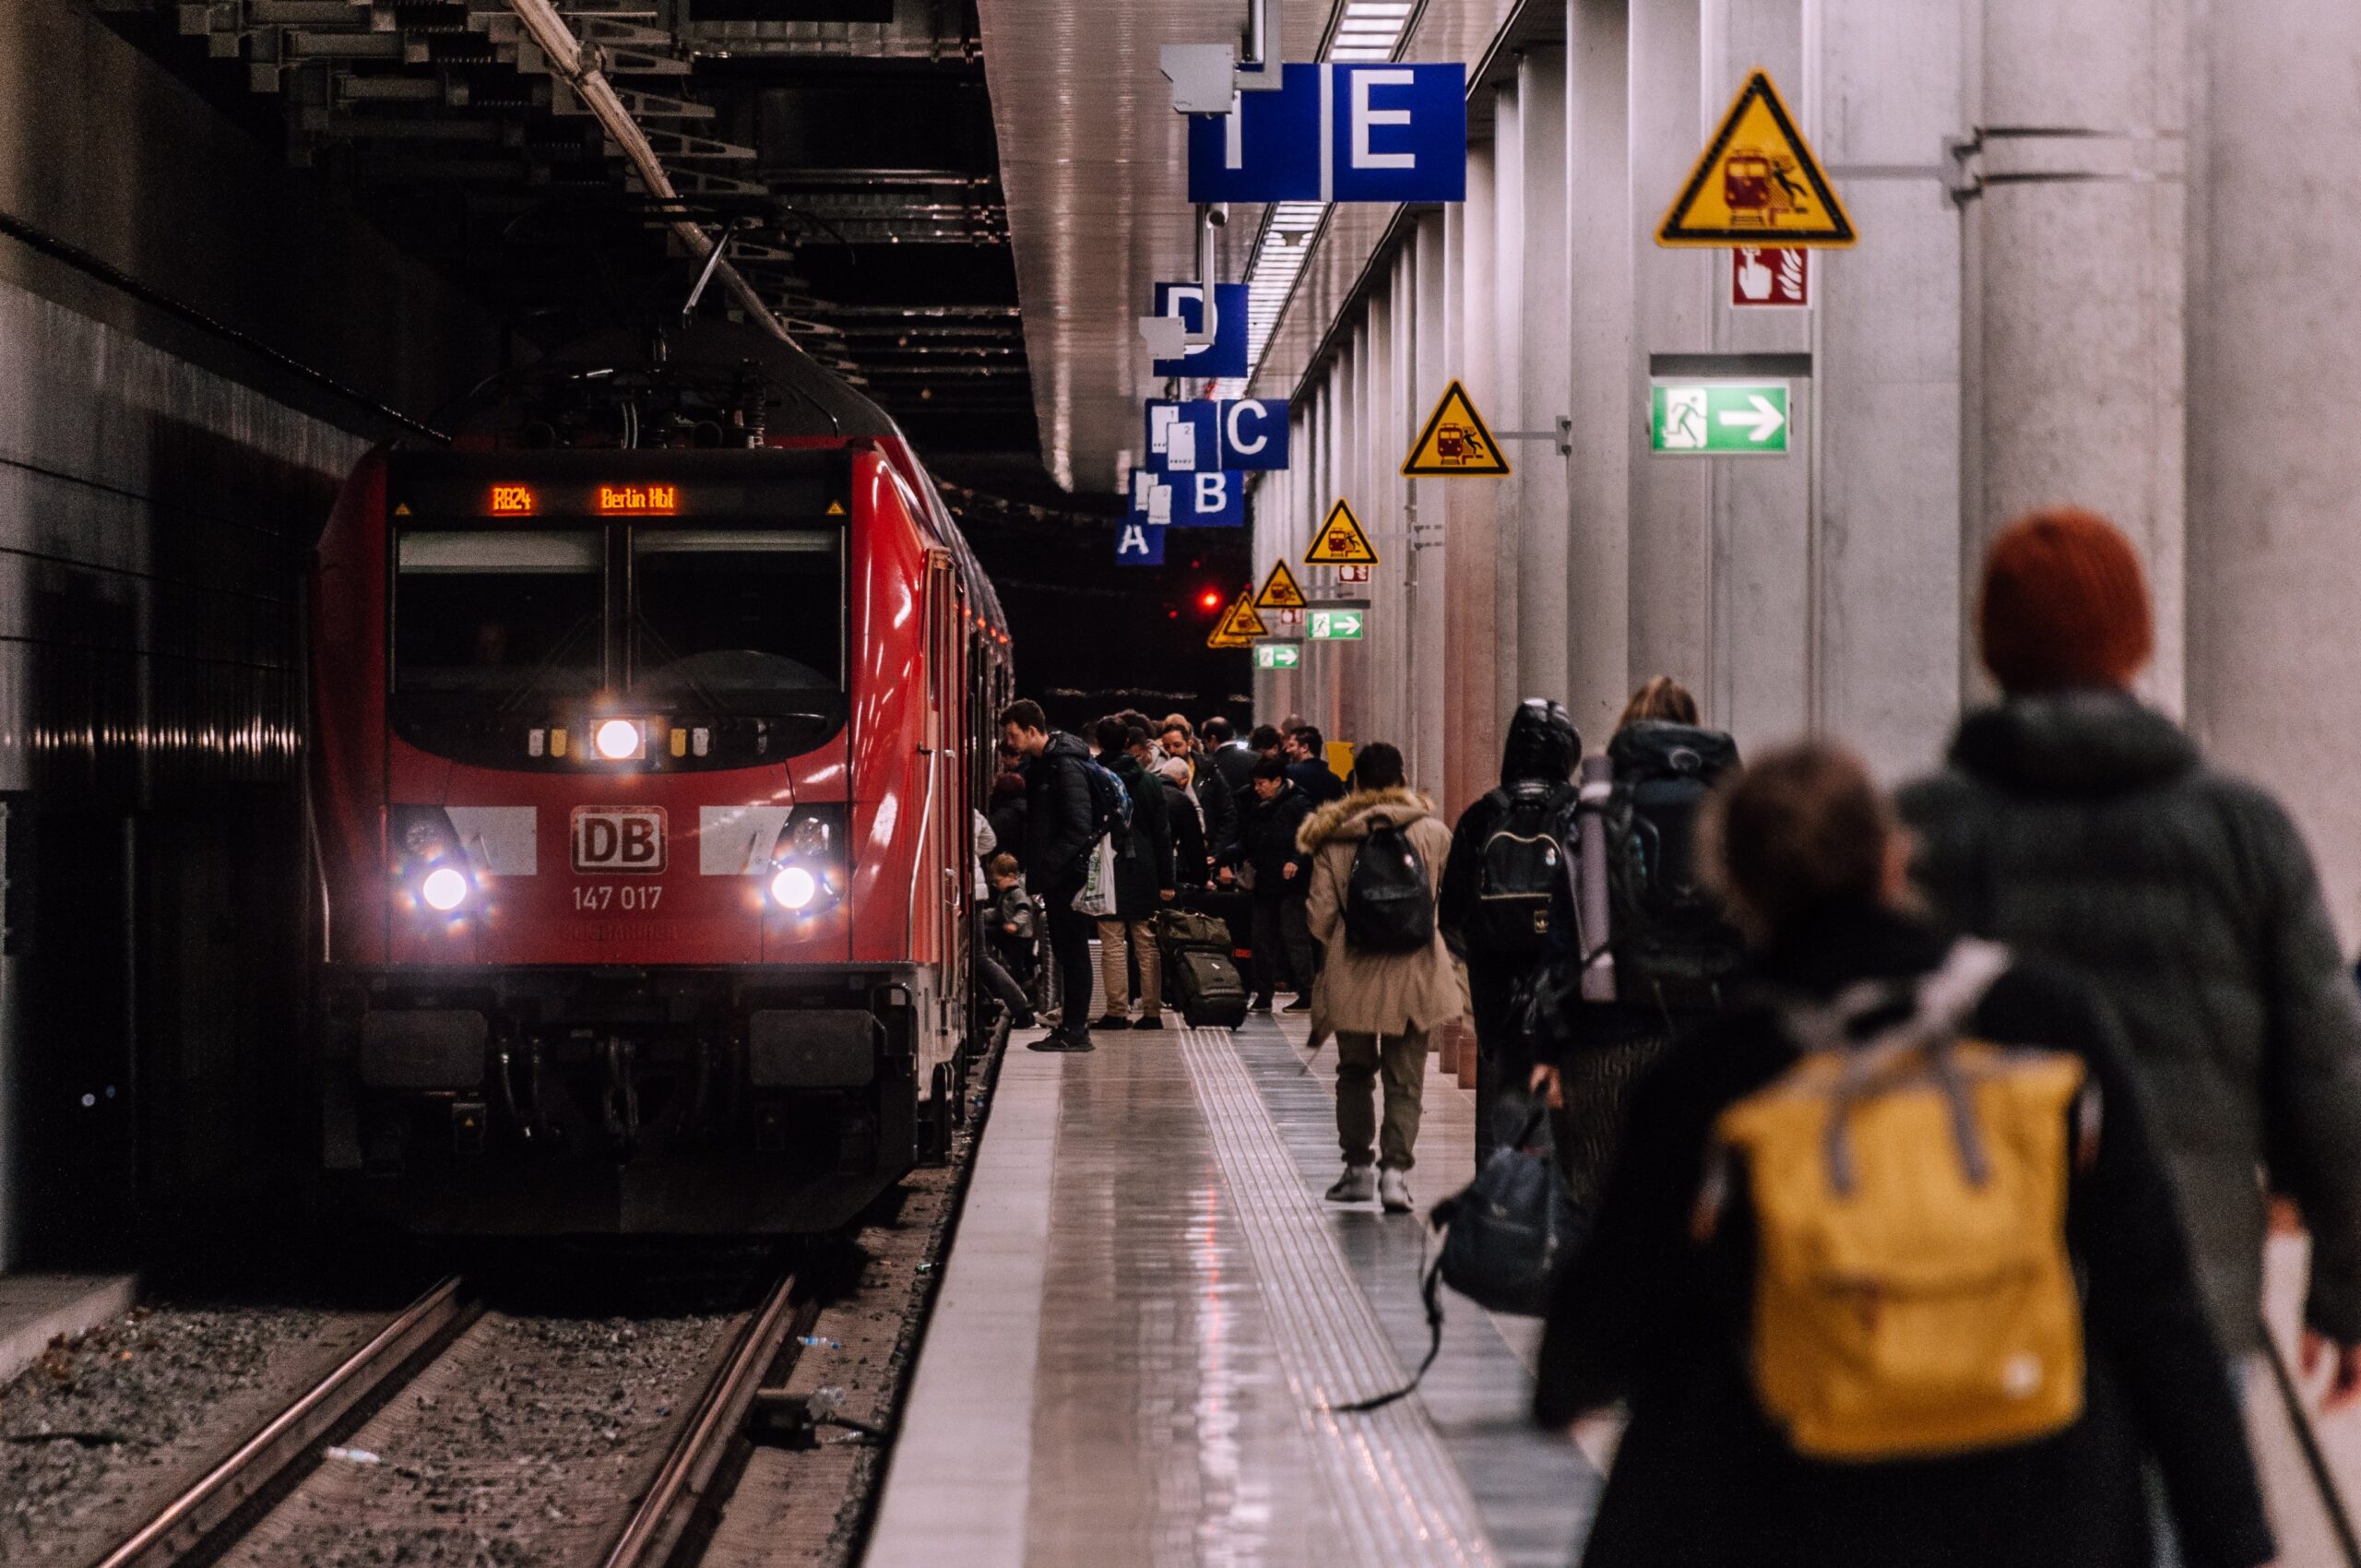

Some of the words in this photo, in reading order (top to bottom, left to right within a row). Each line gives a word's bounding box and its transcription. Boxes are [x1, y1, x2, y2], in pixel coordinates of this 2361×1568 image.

[1350, 69, 1416, 169] E
[1168, 287, 1218, 355] D
[1227, 399, 1268, 455] C
[493, 487, 531, 510] RB24
[601, 487, 647, 508] Berlin
[1194, 472, 1228, 513] B
[1118, 524, 1150, 555] A
[581, 815, 658, 864] DB
[573, 886, 613, 910] 147
[621, 886, 662, 910] 017
